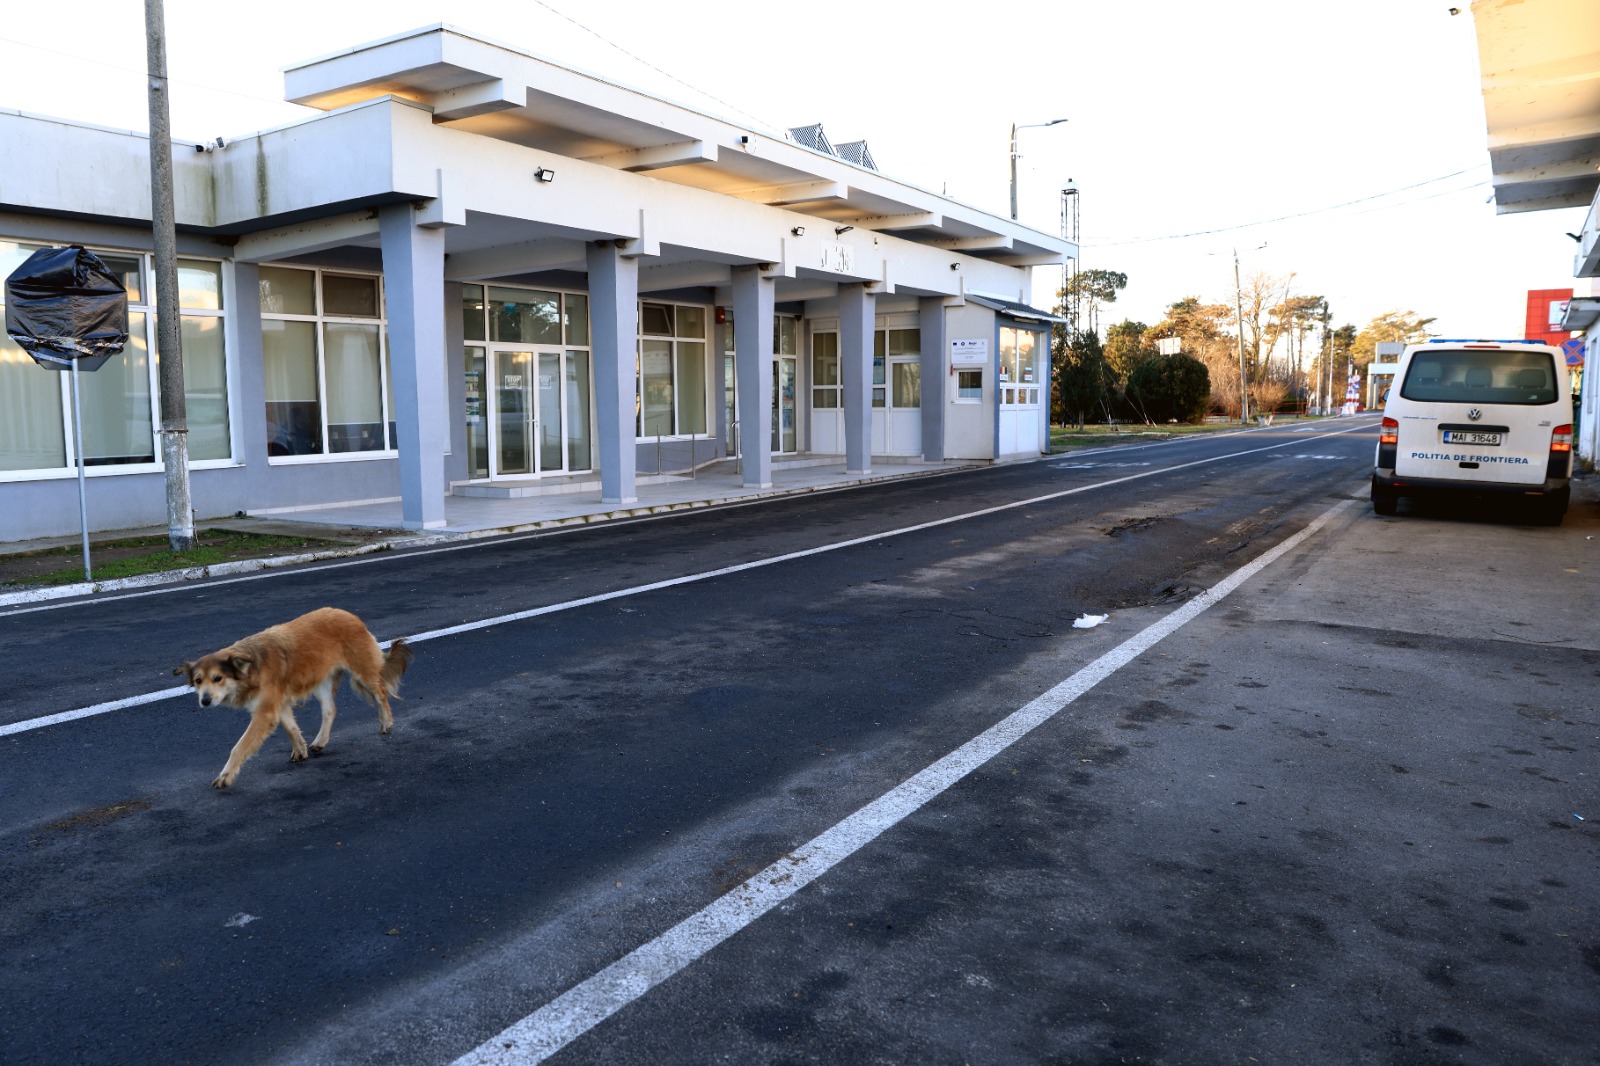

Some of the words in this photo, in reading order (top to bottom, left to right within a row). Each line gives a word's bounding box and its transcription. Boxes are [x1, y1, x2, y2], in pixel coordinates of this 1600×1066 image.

[1451, 432, 1467, 442] MAI
[1471, 433, 1498, 443] 31648
[1412, 452, 1450, 460] POLITIA
[1470, 455, 1529, 464] FRONTIERA
